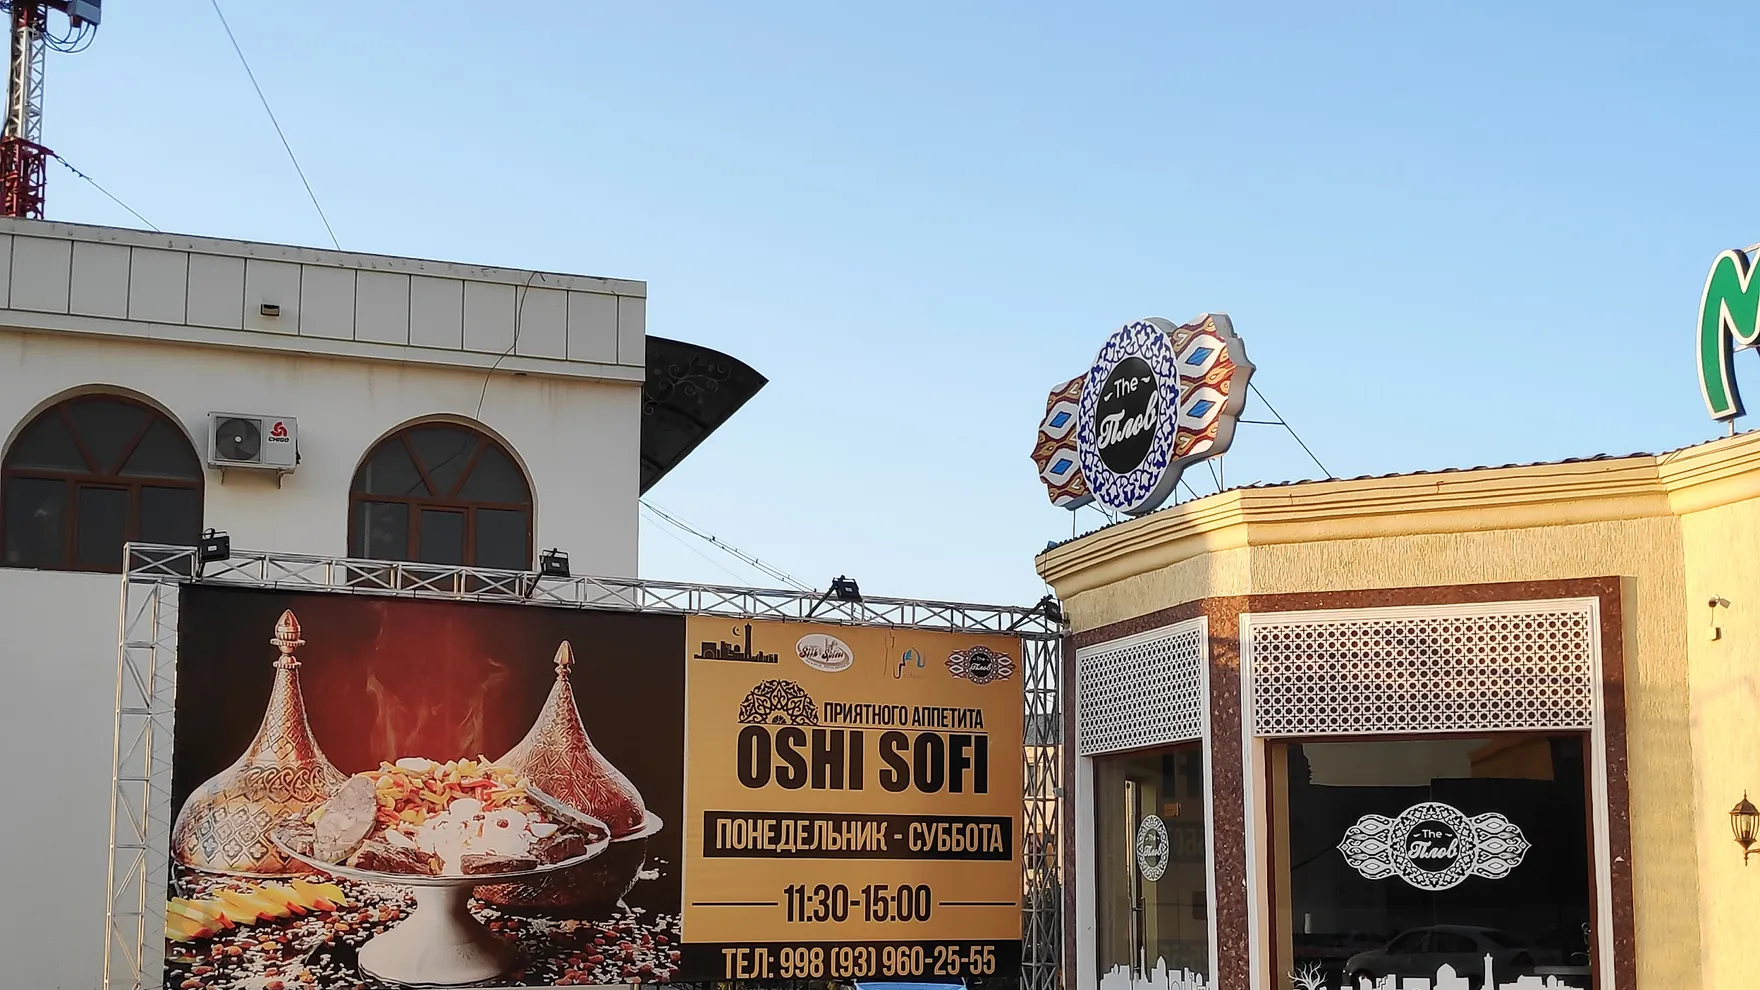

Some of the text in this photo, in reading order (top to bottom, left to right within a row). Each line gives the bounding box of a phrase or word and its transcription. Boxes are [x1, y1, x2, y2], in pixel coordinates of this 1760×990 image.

[1113, 377, 1138, 400] The
[1097, 390, 1159, 449] Плов
[823, 702, 984, 729] ПРИЯТНОГО АППЕТИТА
[737, 725, 989, 794] OSHI SOFI
[716, 818, 888, 853] ПОНЕДЕЛЬНИК
[908, 822, 1004, 853] СУББОТА
[1407, 837, 1460, 859] Плов
[1421, 829, 1443, 840] The
[783, 883, 932, 923] 11:30-15:00
[722, 945, 996, 979] ТЕЛ: 998 (93) 960-25-55
